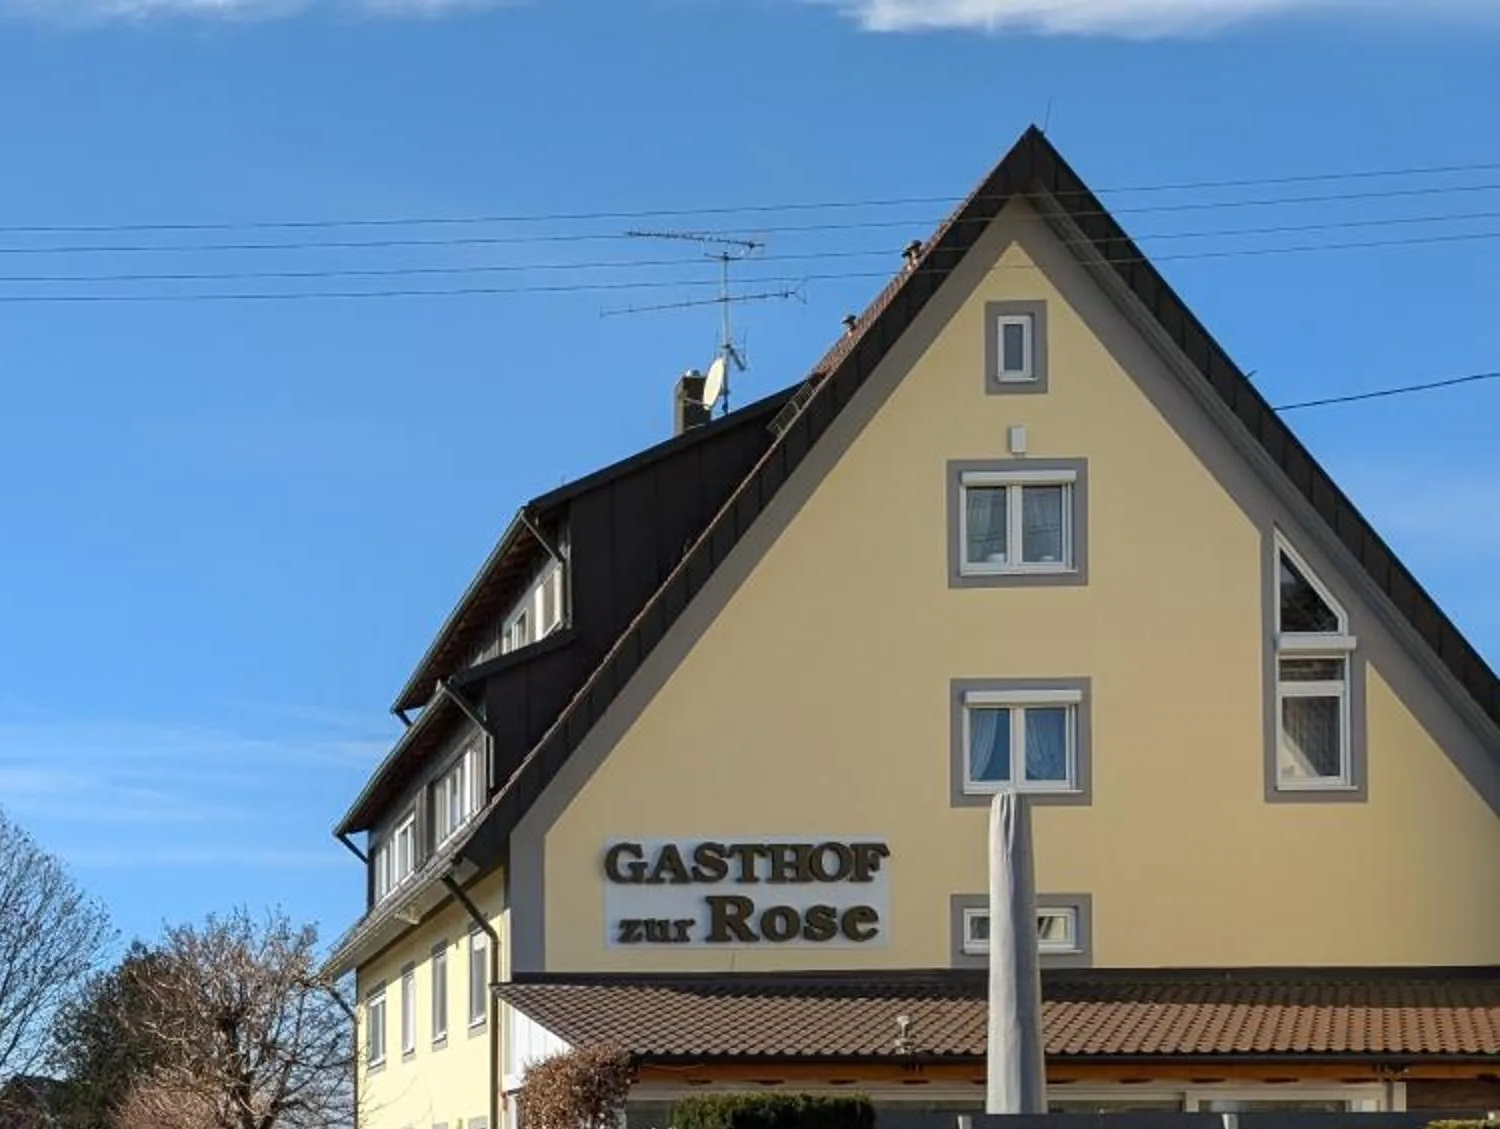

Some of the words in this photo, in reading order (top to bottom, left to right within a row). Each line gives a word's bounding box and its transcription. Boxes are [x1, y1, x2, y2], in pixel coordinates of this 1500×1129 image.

[604, 841, 891, 885] GASTHOF
[616, 917, 696, 944] zur
[704, 894, 880, 943] Rose
